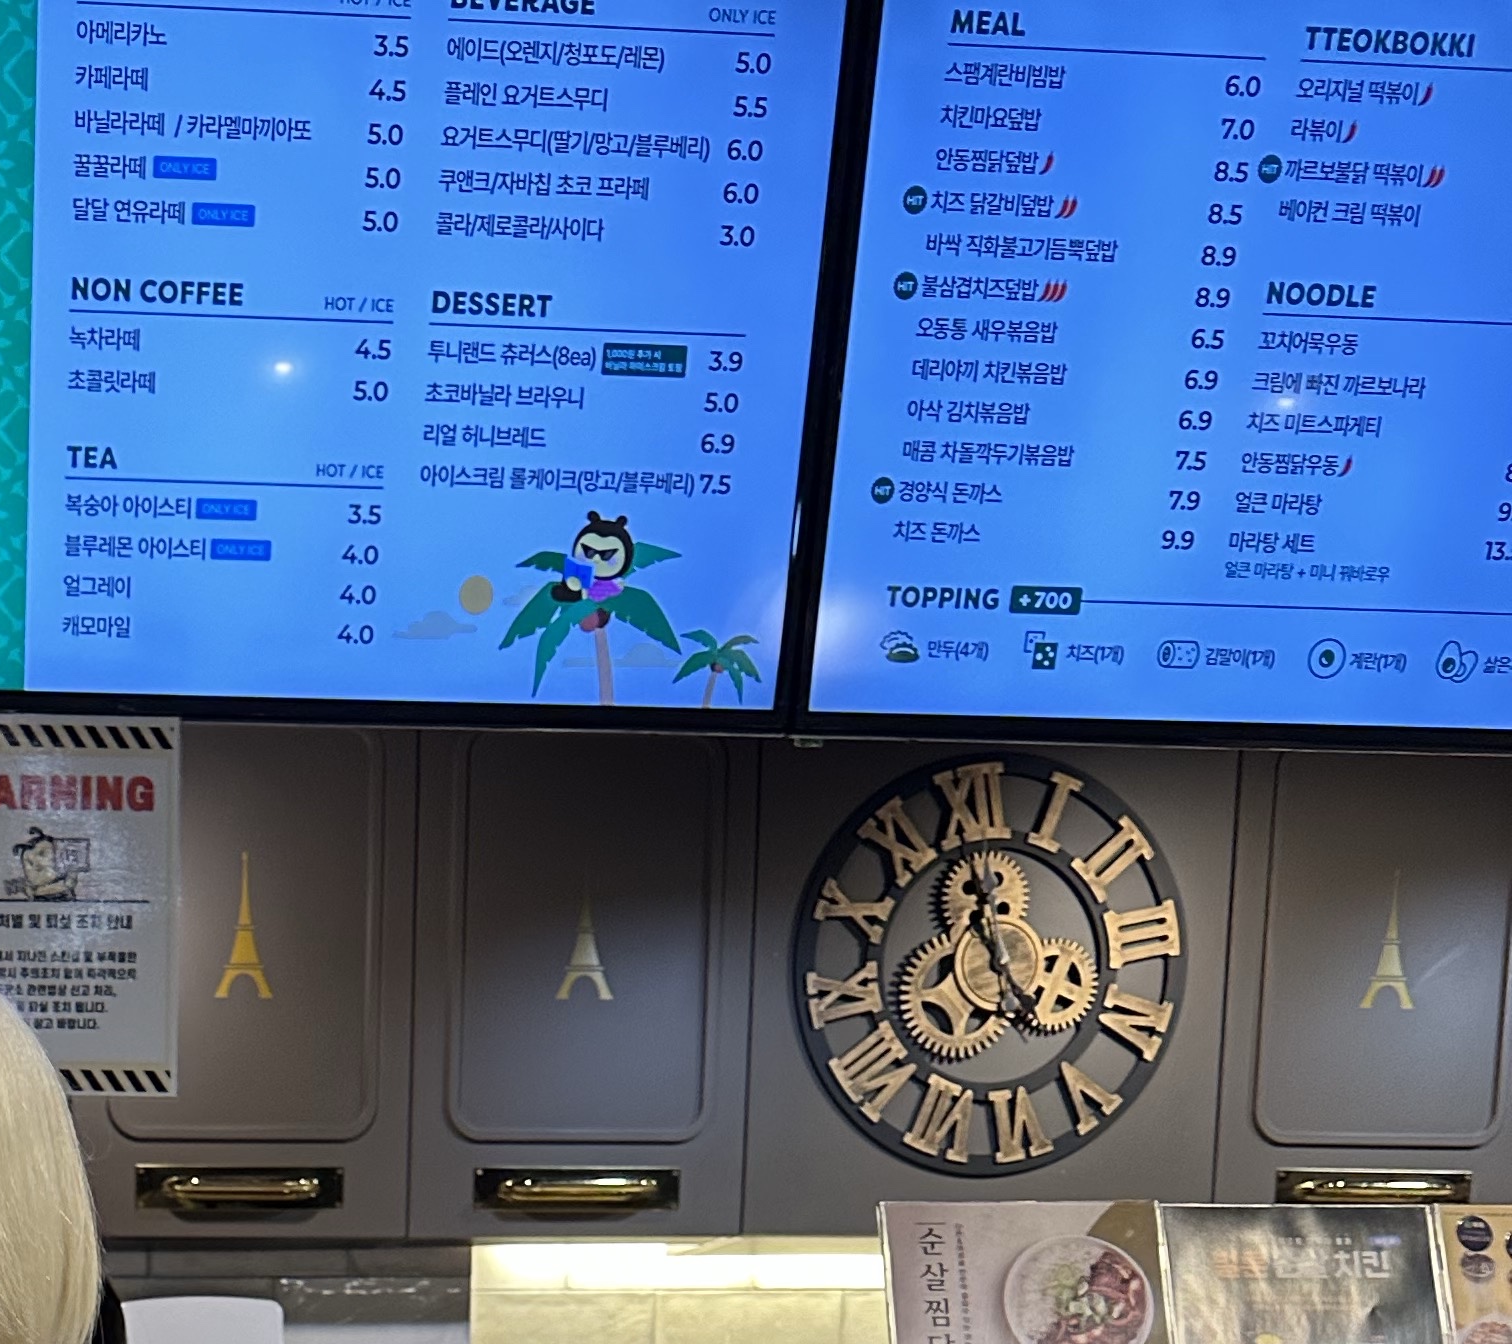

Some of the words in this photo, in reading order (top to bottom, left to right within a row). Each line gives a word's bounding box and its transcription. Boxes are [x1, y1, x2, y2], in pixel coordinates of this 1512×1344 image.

[709, 8, 747, 24] ONLY
[753, 10, 776, 25] ICE
[951, 9, 1026, 37] MEAL
[77, 20, 168, 45] 아메리카노
[374, 34, 409, 57] 3.5
[1306, 26, 1475, 58] TTEOKBOKKI
[736, 52, 771, 74] 5.0
[75, 65, 148, 91] 카페라떼
[369, 78, 406, 101] 4.5
[1296, 77, 1364, 102] 오리지널
[1369, 82, 1418, 105] 떡볶이
[444, 81, 497, 107] 플레인
[503, 84, 608, 111] 요거트스무디
[733, 95, 767, 118] 5.5
[74, 110, 165, 136] 바닐라라떼
[187, 114, 312, 141] 카라멜마끼아또
[367, 123, 403, 146] 5.0
[1291, 118, 1343, 143] 라볶이
[727, 139, 763, 161] 6.0
[73, 154, 146, 179] 꿀꿀라떼
[365, 167, 401, 189] 5.0
[439, 170, 550, 196] 쿠앤크/자바칩
[556, 176, 592, 196] 초코
[596, 176, 649, 201] 프라페
[723, 183, 759, 204] 6.0
[72, 198, 108, 221] 달달
[113, 200, 186, 224] 연유라떼
[362, 210, 398, 232] 5.0
[931, 190, 964, 214] 치즈
[1279, 199, 1329, 222] 베이컨
[1332, 201, 1366, 224] 크림
[1370, 203, 1421, 227] 떡볶이
[436, 211, 605, 241] 콜라/제로콜라/사이다
[720, 225, 754, 247] 3.0
[926, 233, 961, 257] 바싹
[71, 277, 131, 302] NON
[141, 279, 243, 305] COFFEE
[325, 297, 353, 311] HOT
[371, 298, 393, 312] ICE
[432, 291, 553, 317] DESSERT
[1266, 281, 1376, 307] NOODLE
[69, 326, 140, 351] 녹차라떼
[355, 339, 392, 360] 4.5
[428, 341, 496, 364] 투니랜드
[709, 351, 743, 372] 3.9
[68, 370, 156, 394] 초콜릿라떼
[353, 381, 388, 401] 5.0
[983, 361, 1067, 386] 치킨볶음밥
[1343, 376, 1425, 399] 까르보나라
[425, 382, 511, 407] 초코바닐라
[516, 386, 584, 409] 브라우니
[704, 393, 738, 413] 5.0
[947, 400, 1030, 425] 김치볶음밥
[1246, 412, 1280, 432] 치즈
[1284, 414, 1382, 437] 미트스파게티
[423, 424, 457, 447] 리얼
[462, 426, 546, 448] 허니브레드
[701, 434, 734, 454] 6.9
[67, 446, 117, 469] TEA
[316, 464, 345, 477] HOT
[361, 465, 383, 479] ICE
[420, 465, 504, 489] 아이스크림
[700, 474, 731, 495] 7.5
[899, 481, 948, 504] 경양식
[952, 483, 1002, 504] 돈까스
[65, 494, 118, 516] 복숭아
[123, 496, 192, 518] 아이스티
[348, 505, 381, 524] 3.5
[1272, 493, 1322, 515] 마라탕
[893, 520, 926, 542] 치즈
[931, 522, 980, 543] 돈까스
[1229, 532, 1279, 553] 마라탕
[1283, 533, 1315, 552] 세트
[65, 535, 133, 558] 블루레몬
[139, 538, 206, 560] 아이스티
[64, 576, 131, 598] 얼그레이
[887, 586, 999, 610] TOPPING
[1019, 591, 1072, 609] +700
[62, 616, 131, 638] 캐모마일
[933, 762, 1012, 851] XII
